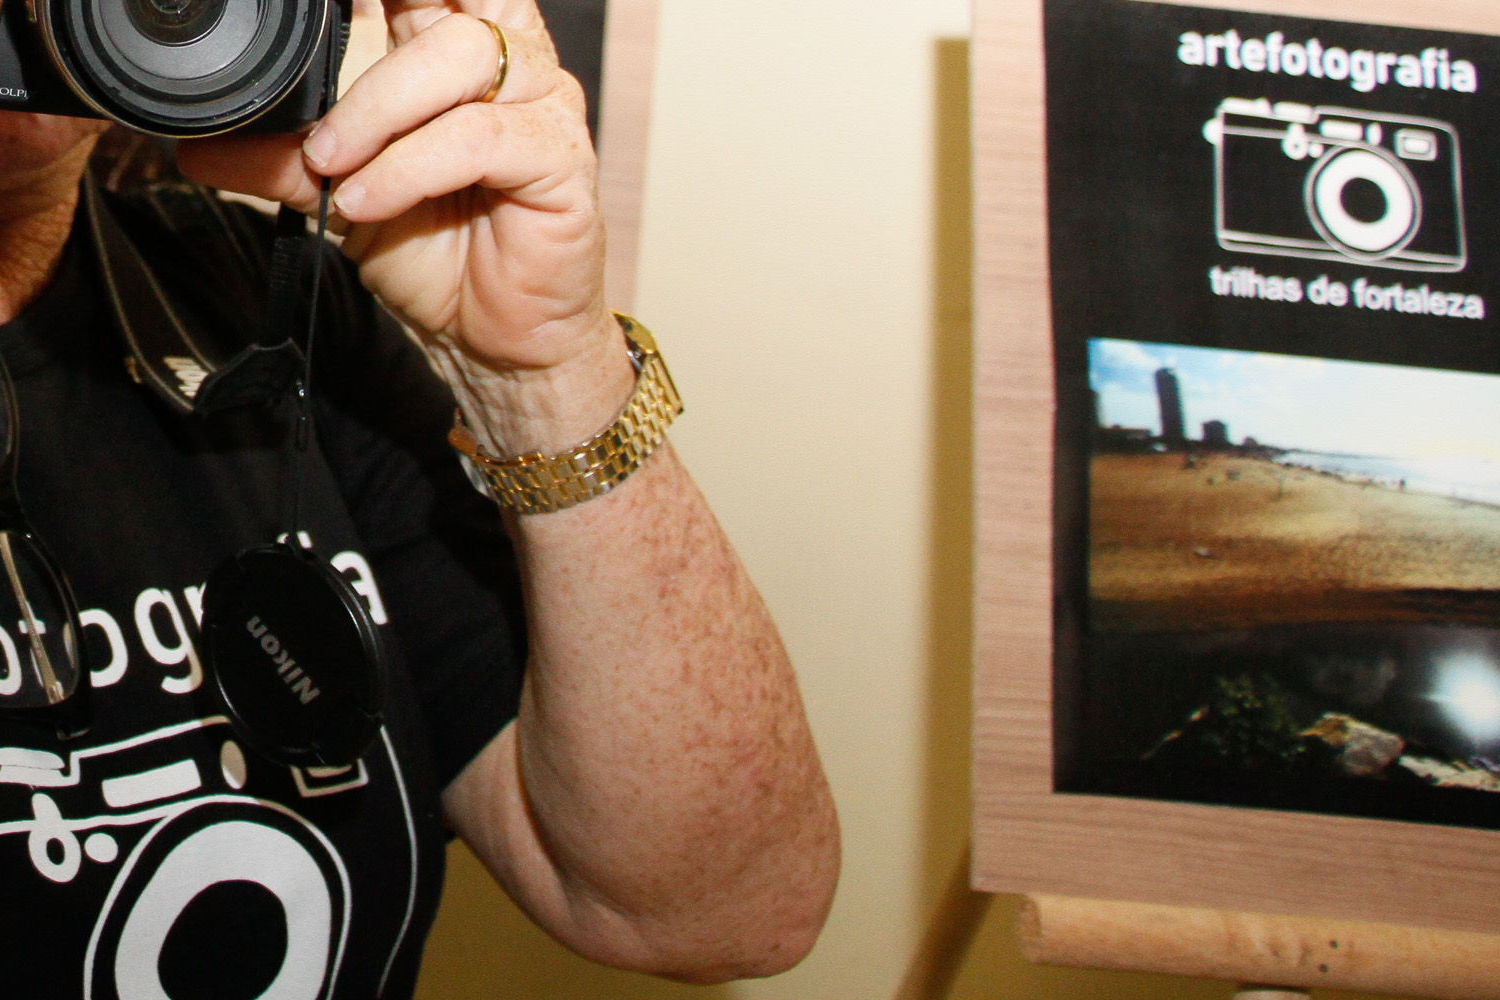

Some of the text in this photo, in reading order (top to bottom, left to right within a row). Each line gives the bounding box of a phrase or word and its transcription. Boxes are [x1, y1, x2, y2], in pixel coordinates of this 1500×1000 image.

[1177, 29, 1478, 93] artefotografia
[1208, 264, 1486, 320] trilhas de fortaleza
